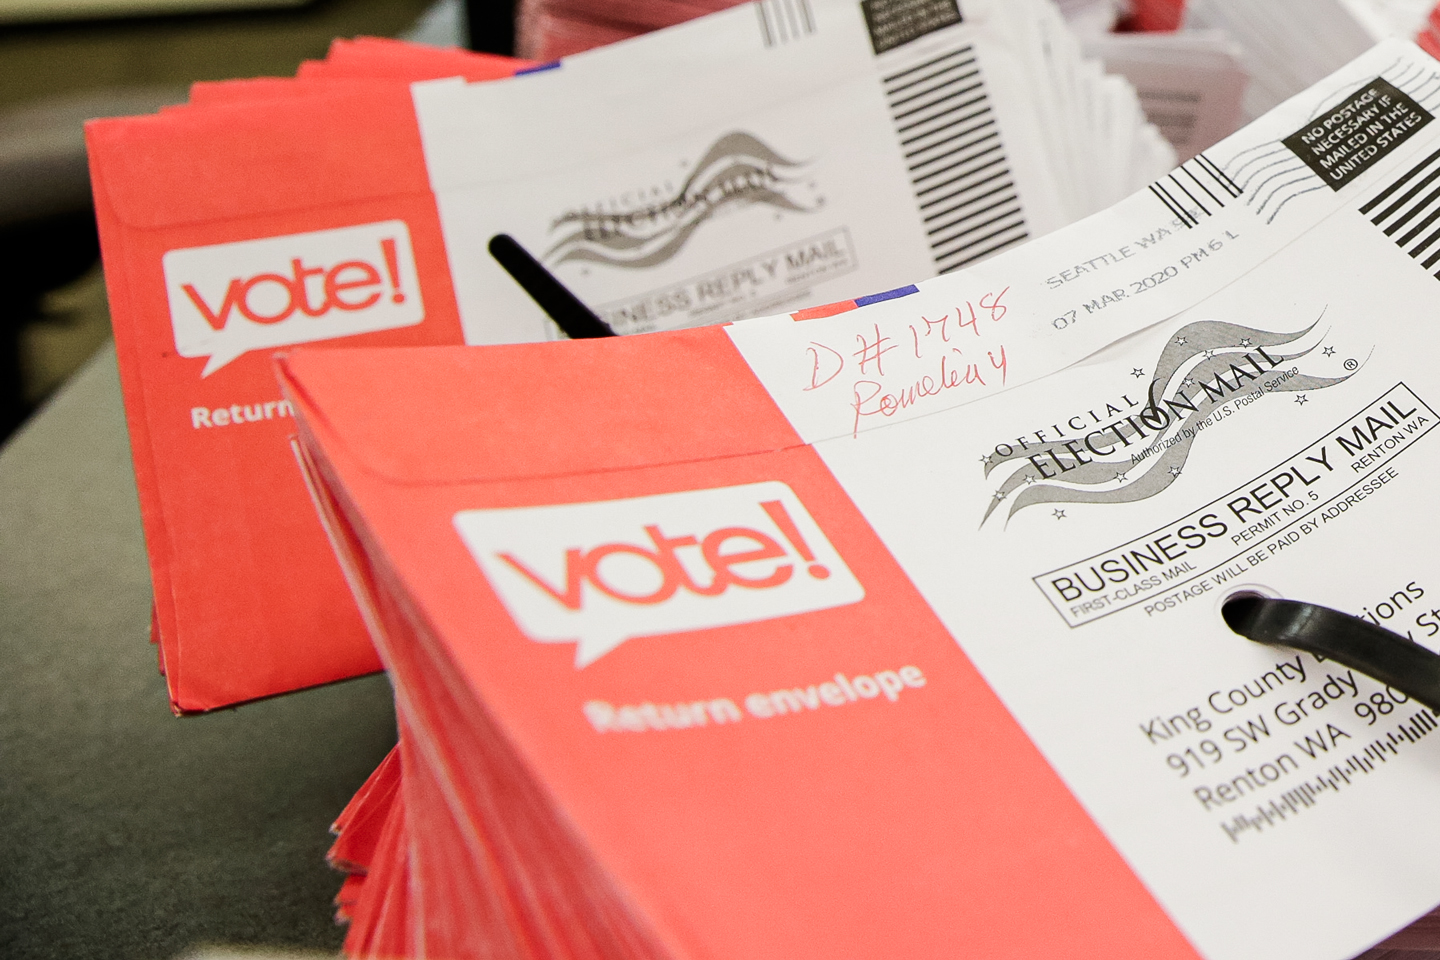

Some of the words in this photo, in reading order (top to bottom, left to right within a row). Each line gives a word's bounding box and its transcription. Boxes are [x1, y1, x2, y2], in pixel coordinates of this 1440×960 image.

[1301, 127, 1324, 144] NO
[1323, 88, 1378, 130] POSTAGE
[1311, 104, 1380, 155] NECESSARY
[1378, 94, 1391, 108] IF
[1319, 133, 1368, 169] MAILED
[1365, 121, 1384, 136] IN
[1380, 102, 1409, 124] THE
[1330, 144, 1378, 180] UNITED
[1376, 112, 1422, 147] STATES
[180, 238, 405, 331] vote!
[1047, 246, 1136, 289] SEATTLE
[1134, 227, 1172, 249] WA
[1052, 310, 1077, 330] 07
[1129, 266, 1178, 294] 2020
[191, 399, 295, 430] Return
[995, 394, 1139, 457] OFFICIAL
[1026, 389, 1199, 479] ELECTION
[1198, 345, 1285, 404] MAIL
[1131, 431, 1182, 465] Authorized
[1182, 427, 1196, 441] by
[1196, 416, 1214, 432] the
[1216, 406, 1235, 422] U.S.
[1234, 389, 1263, 410] Postal
[1264, 366, 1300, 393] Service
[1350, 431, 1406, 473] RENTON
[1403, 415, 1429, 434] WA
[1051, 513, 1228, 602] BUSINESS
[1227, 446, 1334, 523] REPLY
[1335, 401, 1417, 457] MAIL
[493, 499, 832, 612] vote!
[1070, 576, 1162, 617] FIRST-CLASS
[1161, 561, 1197, 581] MAIL
[1231, 511, 1282, 546] PERMIT
[1282, 499, 1309, 516] NO.
[1308, 490, 1319, 501] 5
[1144, 580, 1213, 616] POSTAGE
[1211, 562, 1249, 586] WILL
[1246, 549, 1269, 567] BE
[1267, 531, 1300, 554] PAID
[1300, 518, 1320, 535] BY
[1321, 466, 1399, 523] ADDRESSEE
[583, 697, 743, 734] Return
[745, 665, 927, 719] envelope
[1139, 708, 1212, 745] King
[1208, 656, 1306, 716] County
[1166, 740, 1222, 778] 919
[1223, 714, 1271, 753] SW
[1274, 670, 1359, 725] Grady
[1194, 753, 1299, 811] Renton
[1294, 723, 1352, 759] WA
